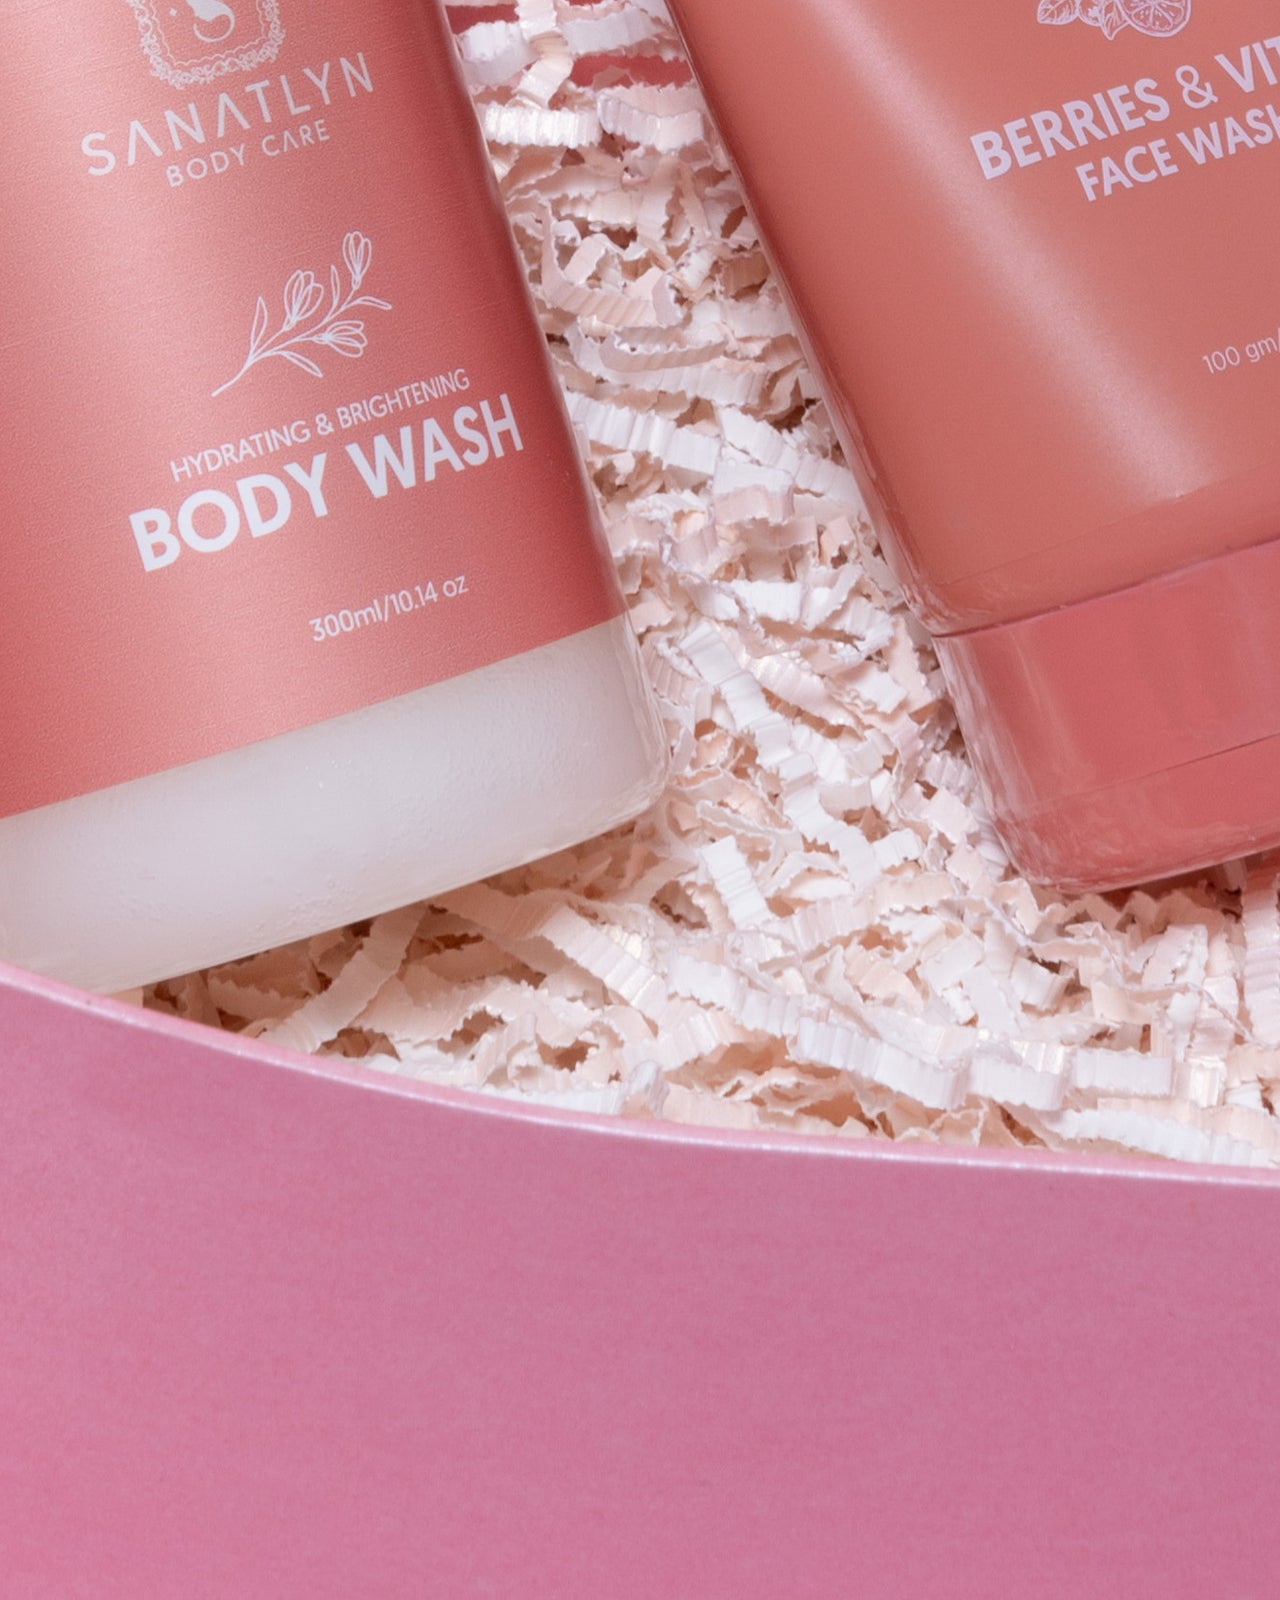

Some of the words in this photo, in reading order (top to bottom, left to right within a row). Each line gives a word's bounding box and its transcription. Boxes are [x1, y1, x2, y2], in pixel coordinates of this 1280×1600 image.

[81, 52, 373, 177] SANATLYN
[166, 143, 246, 188] BODY
[261, 119, 330, 156] CARE
[970, 78, 1170, 180] BERRIES
[1175, 64, 1218, 109] &
[1075, 138, 1179, 202] FACE
[1202, 346, 1241, 374] 100
[170, 420, 311, 483] HYDRATING
[315, 413, 334, 436] &
[336, 368, 470, 430] BRIGHTENING
[129, 452, 329, 573] BODY
[345, 393, 524, 499] WASH
[308, 580, 438, 642] 300ml/10.14
[442, 575, 469, 598] oz
